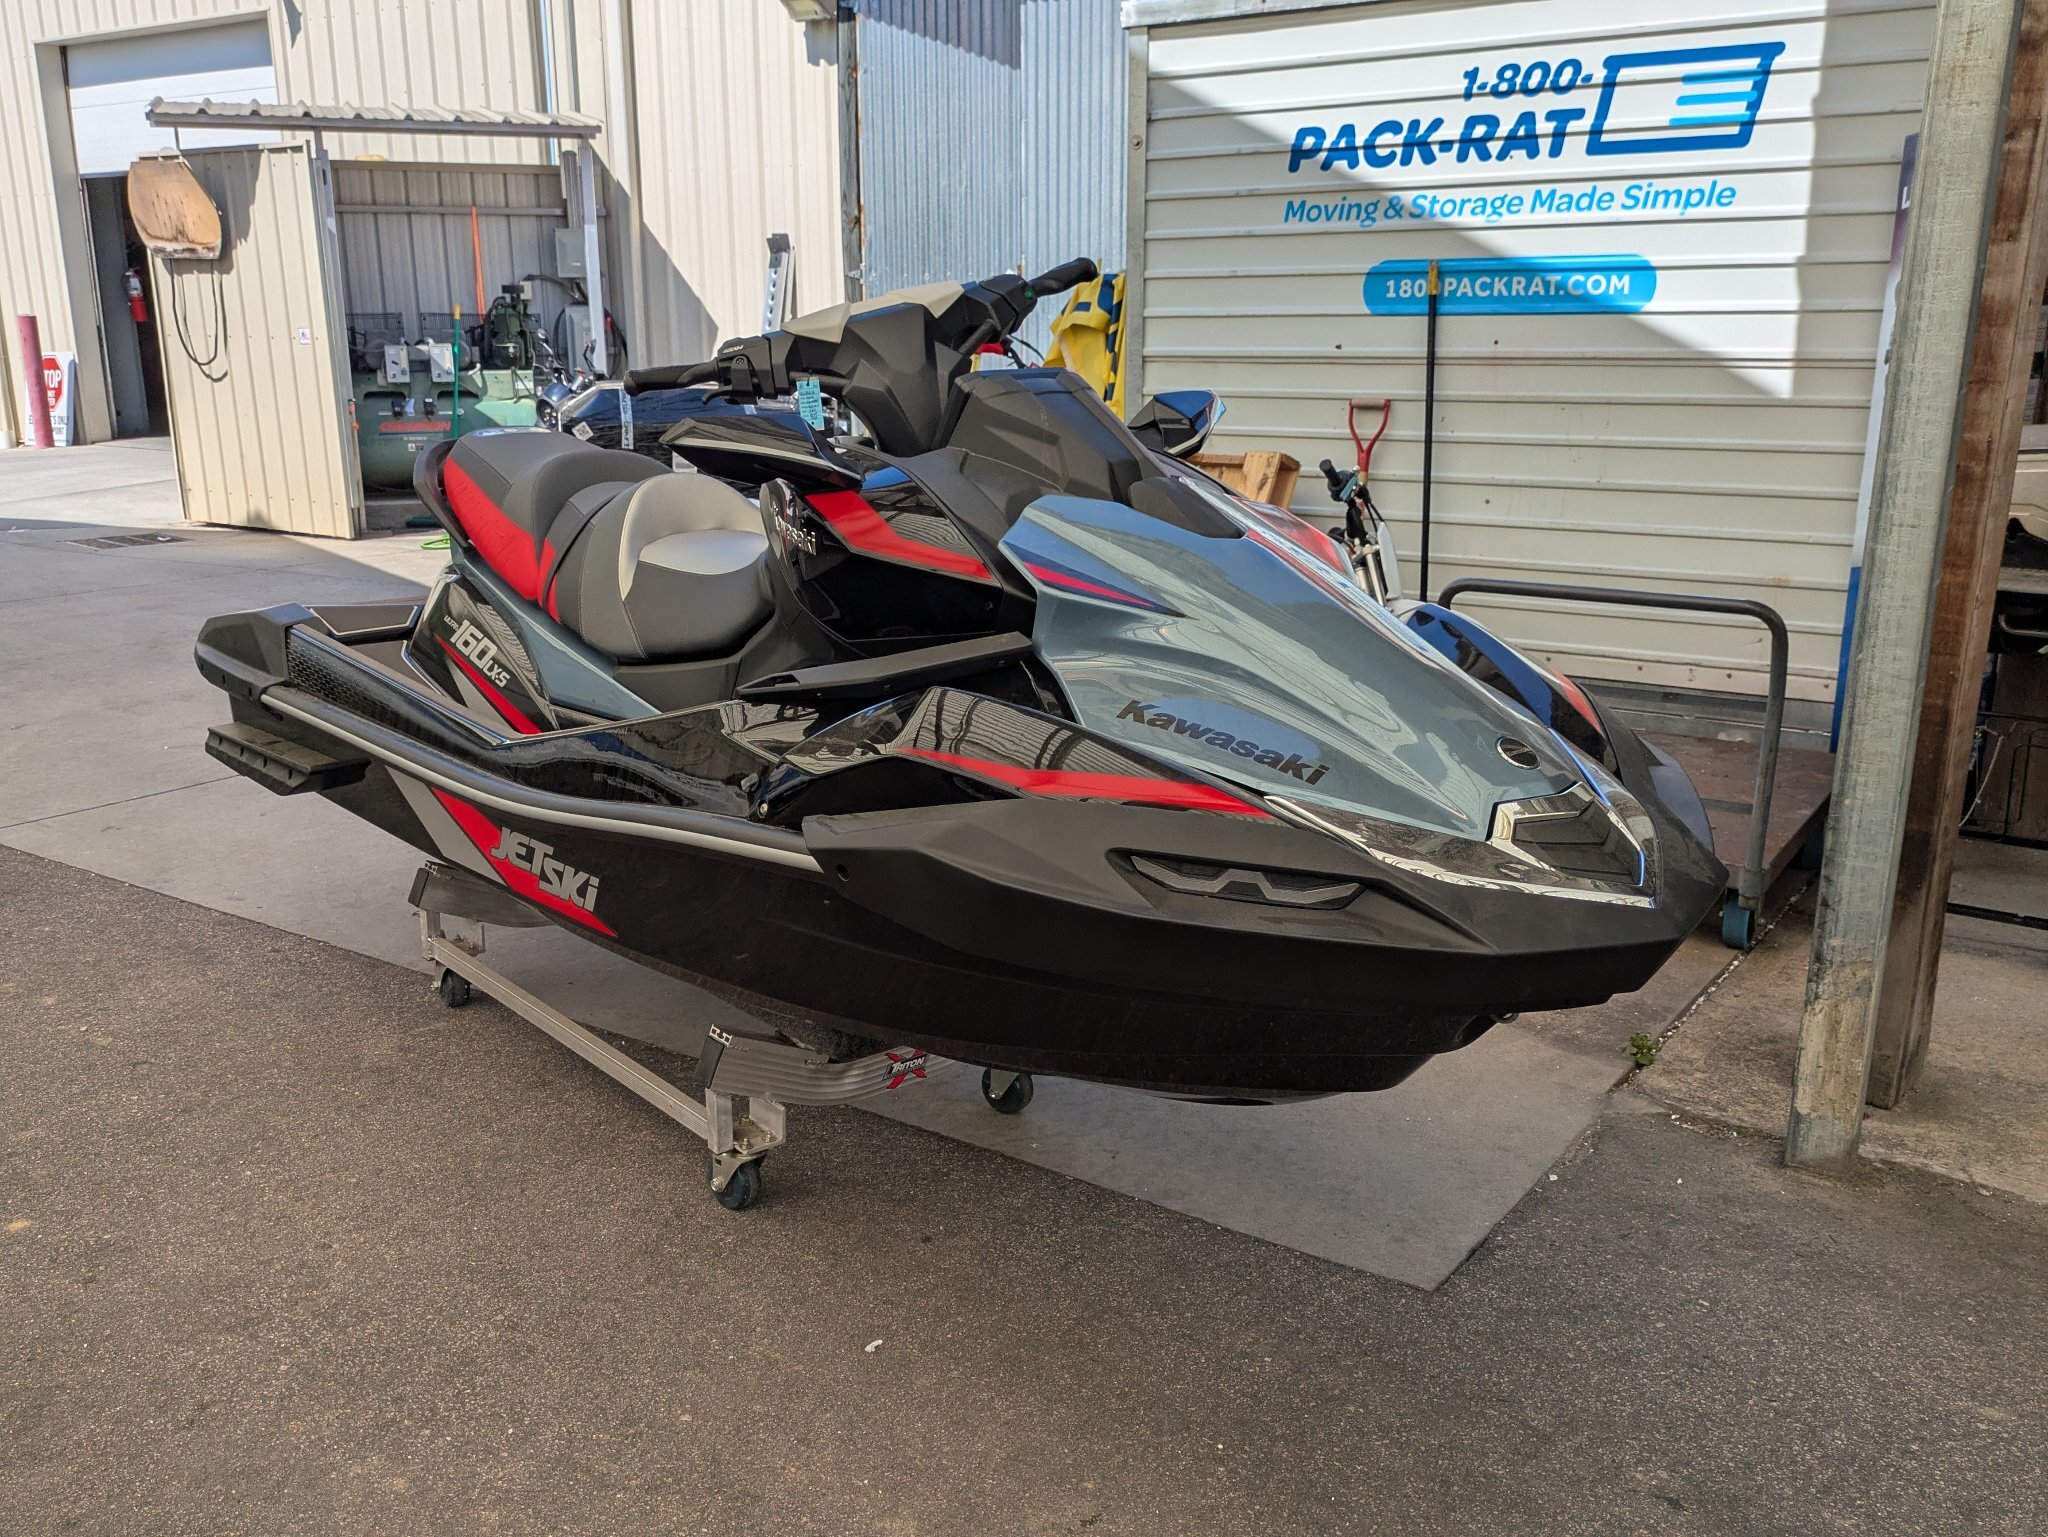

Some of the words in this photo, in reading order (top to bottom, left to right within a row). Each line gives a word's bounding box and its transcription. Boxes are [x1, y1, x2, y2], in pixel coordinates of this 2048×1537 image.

[1462, 58, 1594, 102] 1-800-
[1288, 107, 1587, 174] PACK-RAT
[1283, 196, 1381, 228] Moving
[1382, 195, 1405, 220] &
[1408, 193, 1524, 224] Storage
[1529, 185, 1615, 213] Made
[1620, 180, 1737, 216] Simple
[43, 369, 62, 389] TOP
[1116, 700, 1331, 786] Kawasaki
